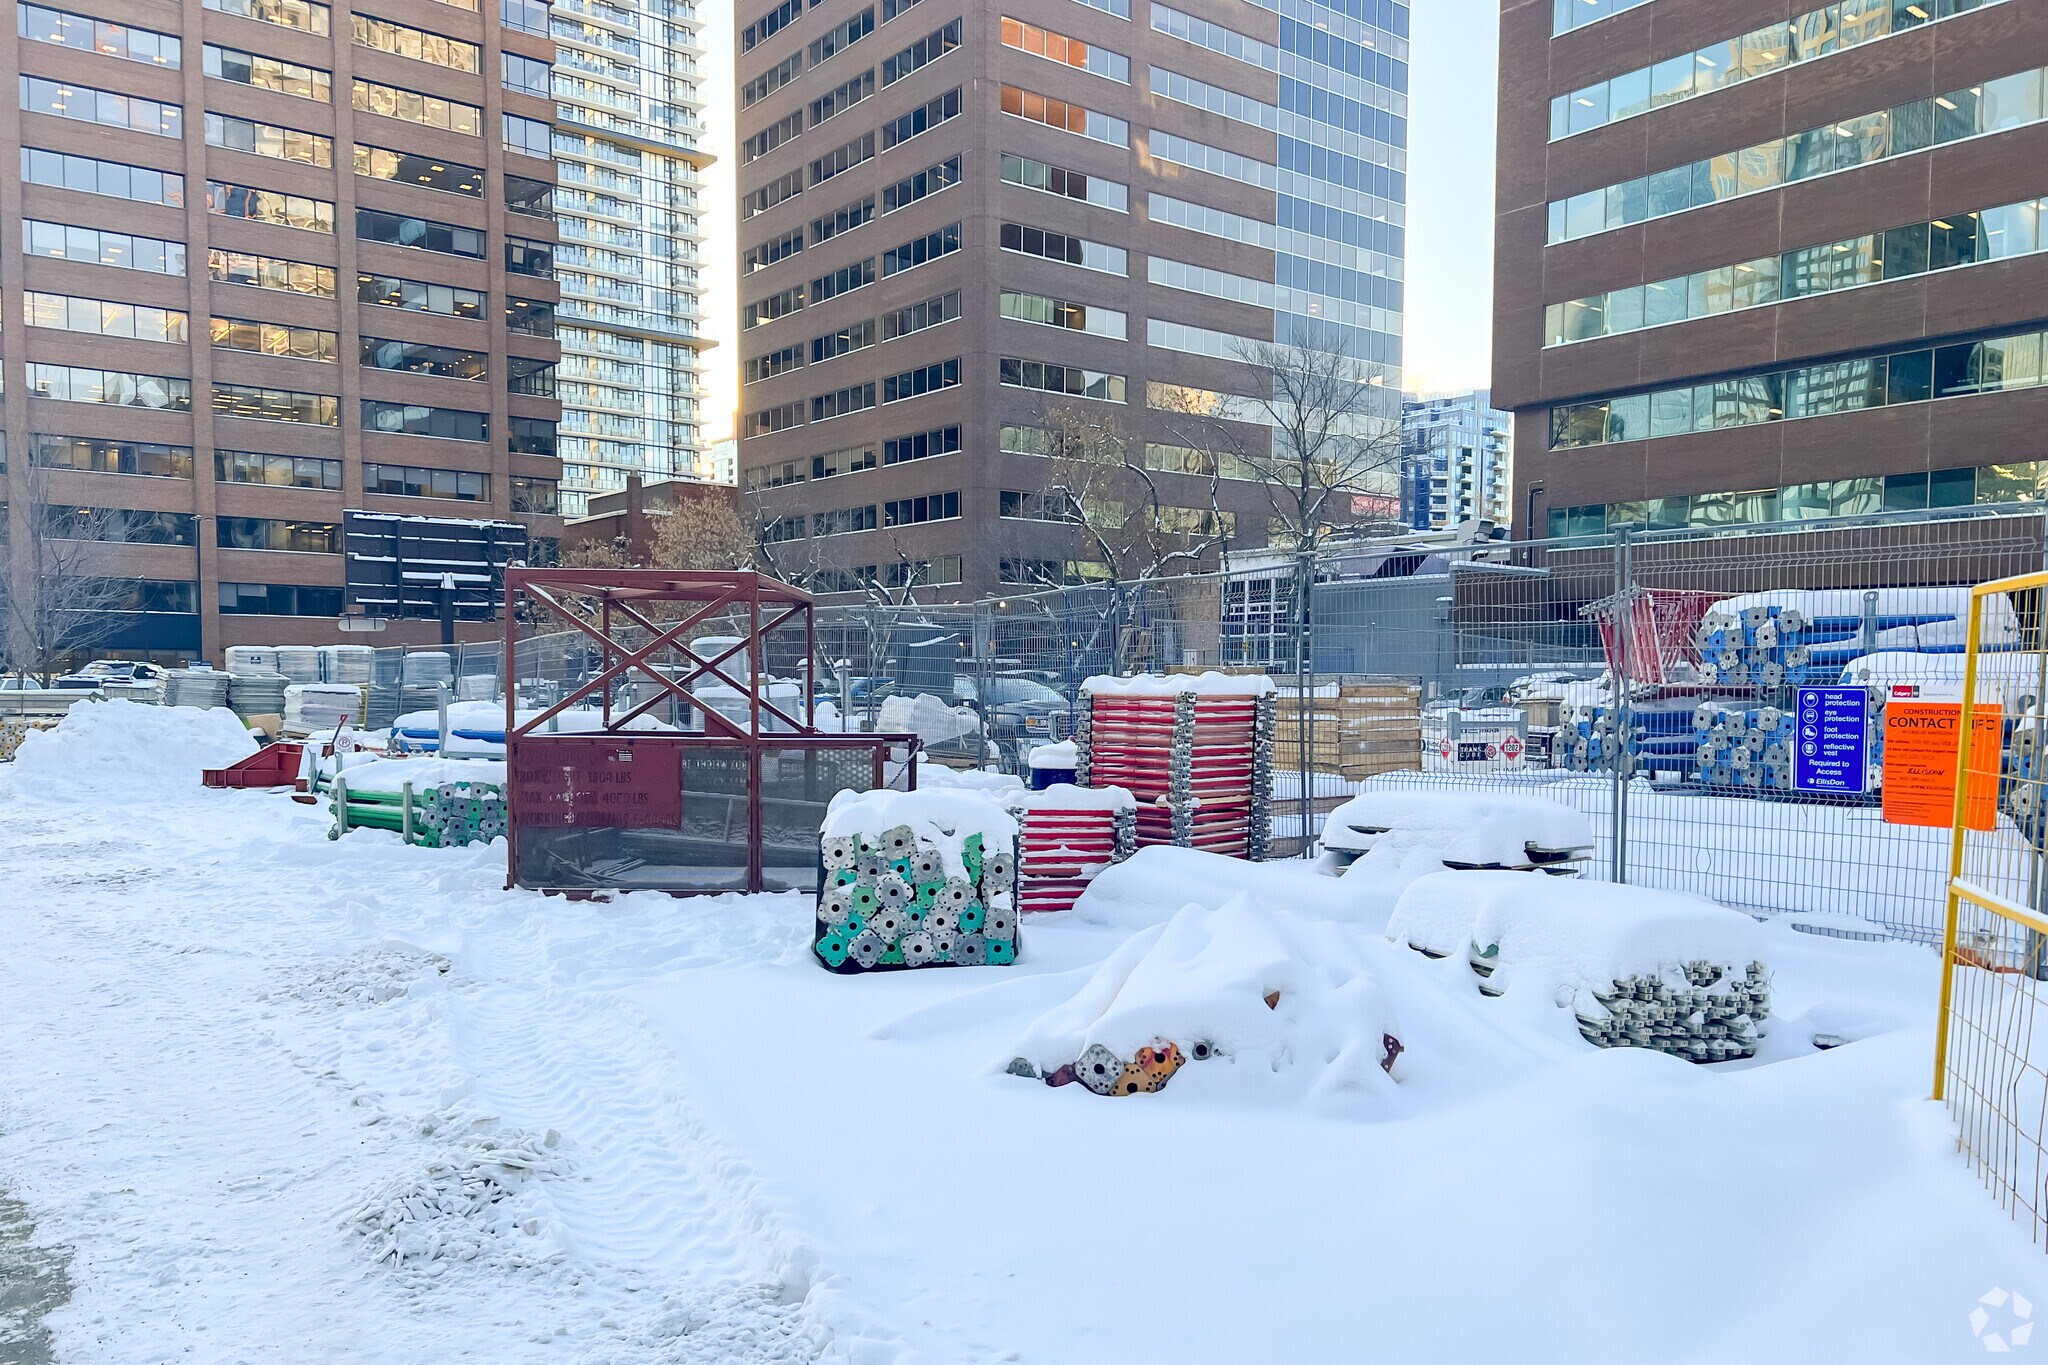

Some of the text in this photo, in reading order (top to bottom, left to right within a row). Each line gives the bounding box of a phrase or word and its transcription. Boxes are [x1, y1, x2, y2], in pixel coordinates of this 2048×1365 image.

[1904, 708, 1962, 716] CONSTRUCTION
[1888, 717, 1957, 729] CONTACT
[1505, 744, 1519, 752] 1202
[1809, 759, 1840, 767] Required
[616, 771, 632, 783] LBS
[1816, 778, 1845, 786] EllisDon
[633, 792, 649, 804] LBS
